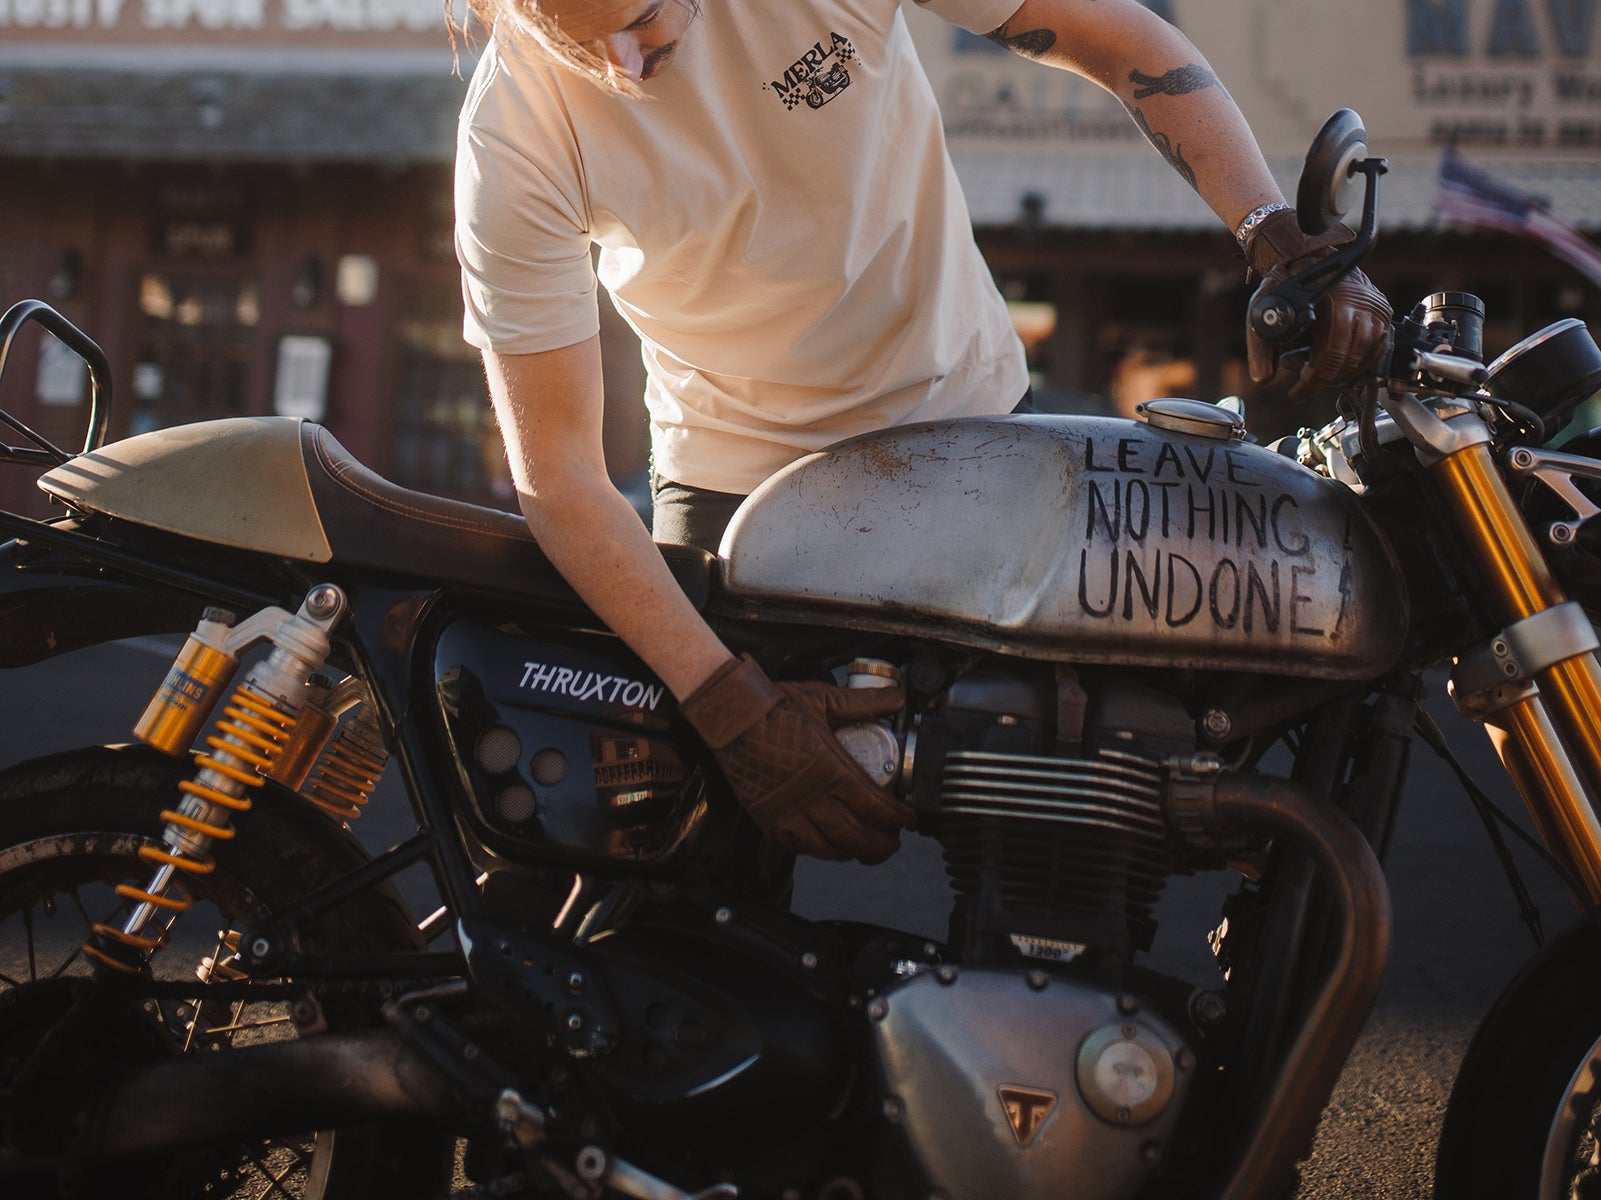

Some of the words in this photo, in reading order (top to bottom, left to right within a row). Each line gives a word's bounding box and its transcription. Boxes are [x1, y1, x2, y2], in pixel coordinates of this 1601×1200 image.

[771, 31, 848, 98] MERLA
[1085, 437, 1261, 486] LEAVE
[1085, 478, 1311, 556] NOTHING
[519, 662, 664, 711] THRUXTON
